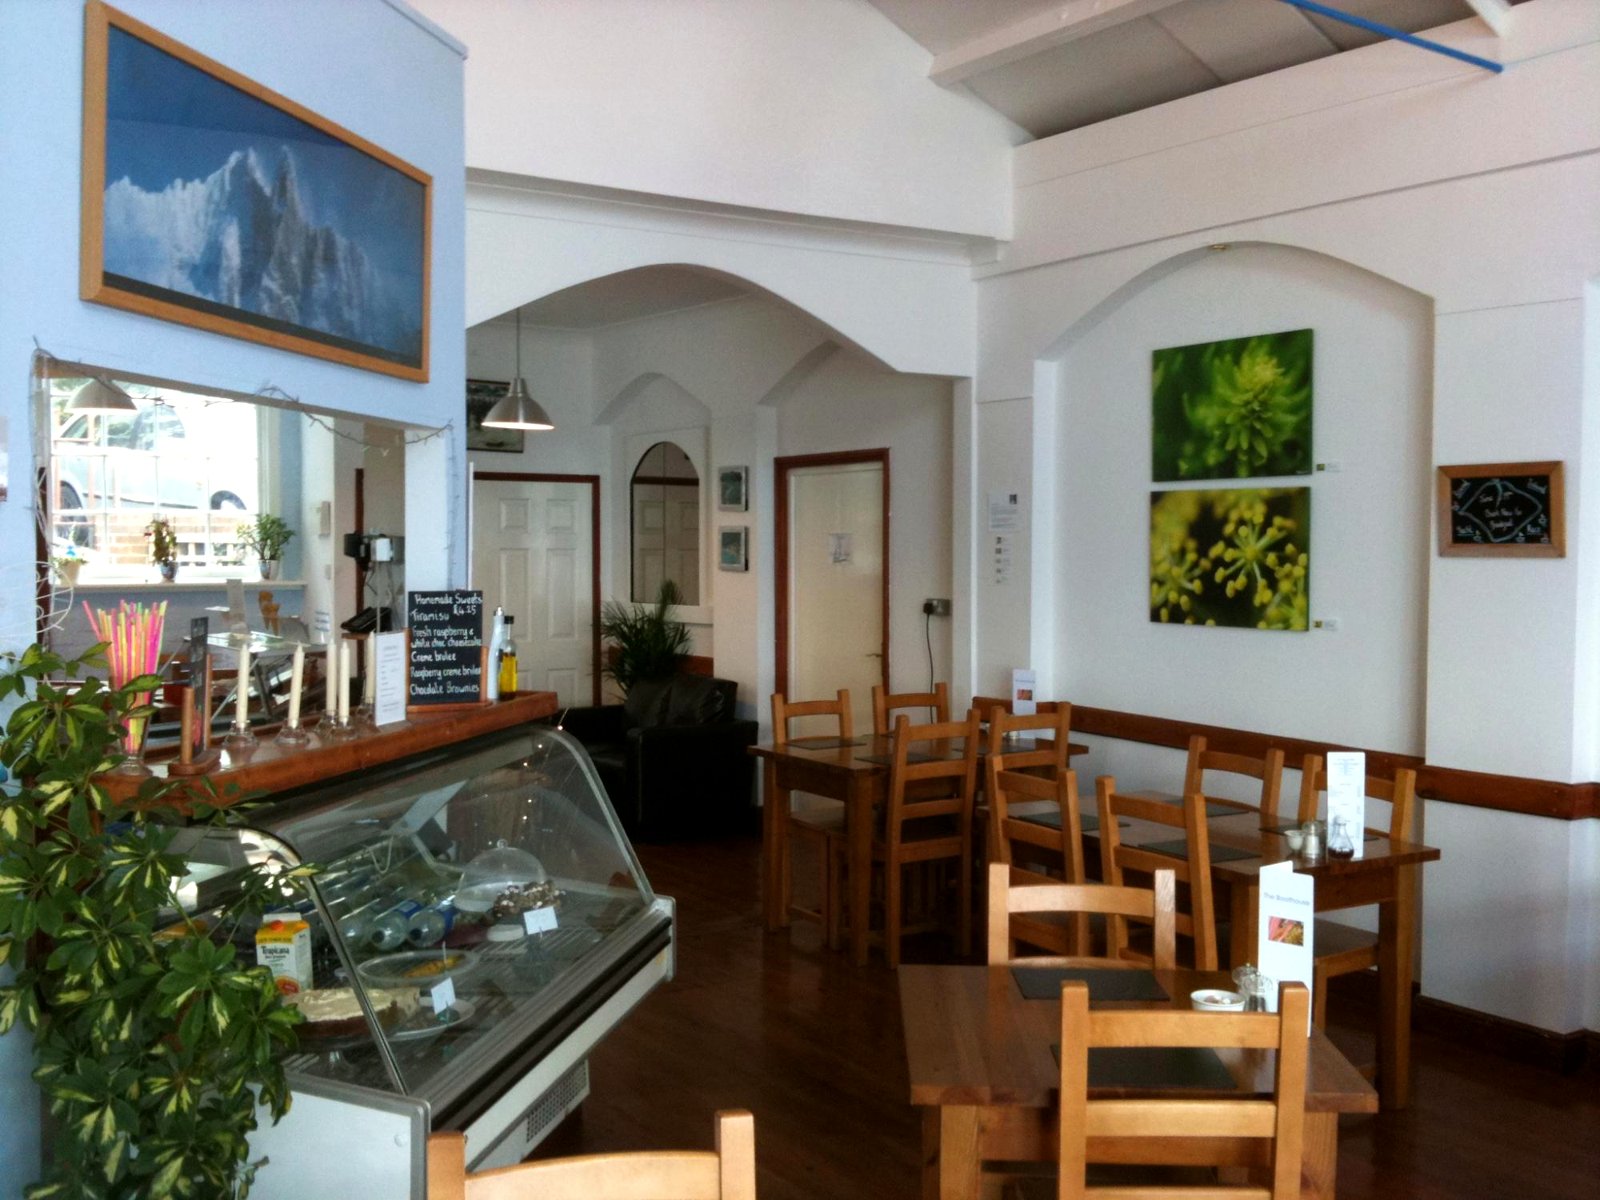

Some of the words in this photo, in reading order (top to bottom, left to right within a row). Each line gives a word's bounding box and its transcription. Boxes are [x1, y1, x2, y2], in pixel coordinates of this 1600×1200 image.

[414, 593, 453, 605] Homemade
[455, 591, 482, 604] Sweets
[410, 608, 450, 621] Tiramisu
